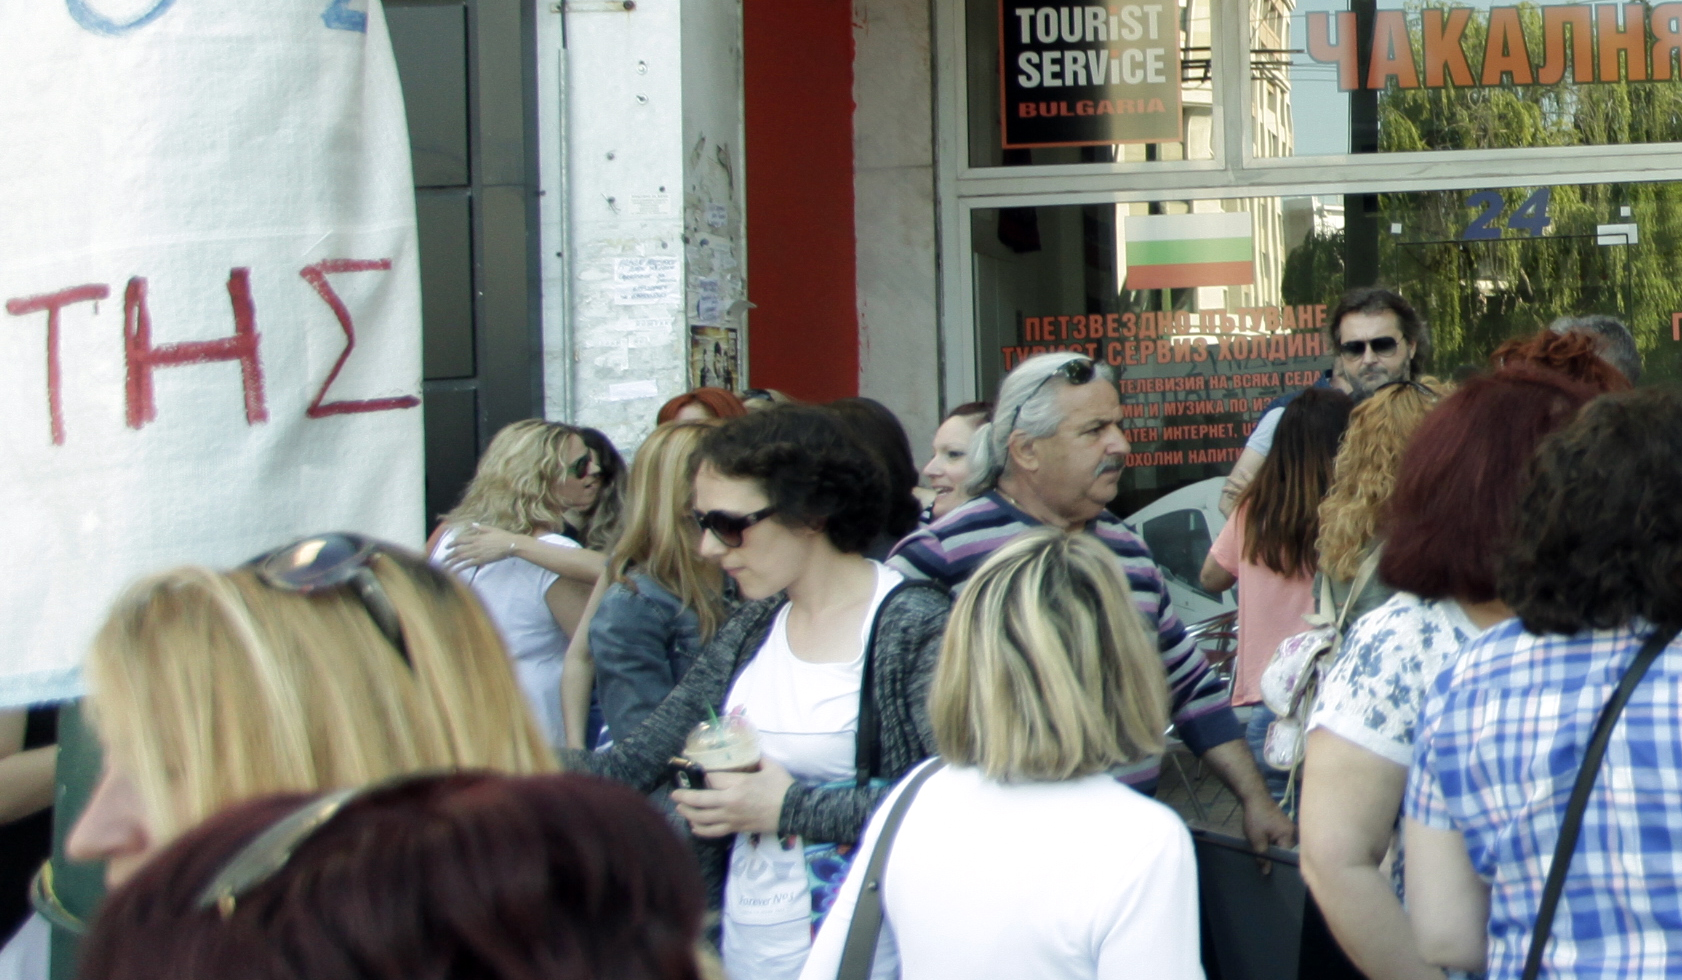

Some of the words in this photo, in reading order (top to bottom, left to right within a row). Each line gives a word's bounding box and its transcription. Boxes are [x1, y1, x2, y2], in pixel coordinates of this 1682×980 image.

[1018, 98, 1167, 119] BULGARIA
[1463, 187, 1552, 240] 24
[1025, 310, 1191, 341] ПЕТЗВЕЗДНО
[1200, 304, 1328, 334] ПЪТУВАНЕ
[5, 259, 422, 446] ΤΗΣ
[1107, 336, 1209, 366] СЕРВИЗ
[1120, 376, 1205, 394] ТЕЛЕВИЗИЯ
[1210, 375, 1228, 389] НА
[1233, 372, 1280, 388] ВСЯКА
[1149, 403, 1159, 417] И
[1164, 400, 1224, 416] МУЗИКА
[1230, 398, 1248, 412] ПО
